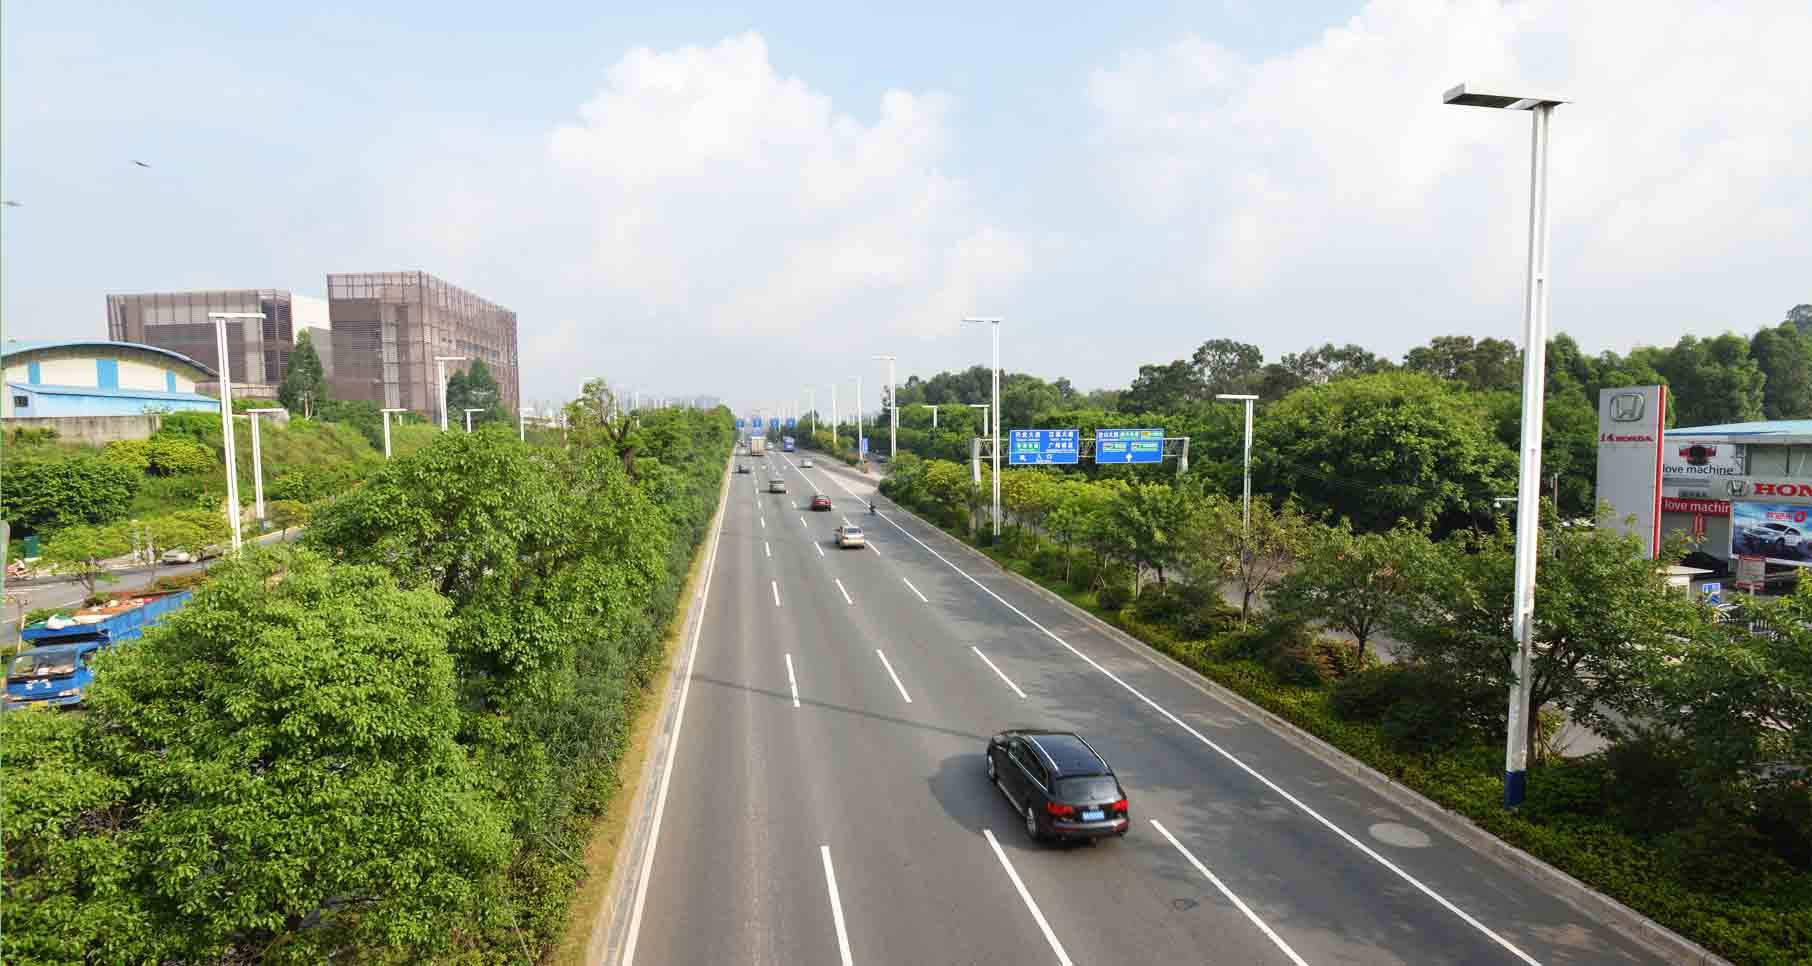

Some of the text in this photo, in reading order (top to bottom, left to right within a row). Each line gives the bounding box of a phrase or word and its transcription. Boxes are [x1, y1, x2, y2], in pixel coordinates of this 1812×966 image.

[1662, 463, 1734, 476] love machine
[1664, 499, 1687, 509] love
